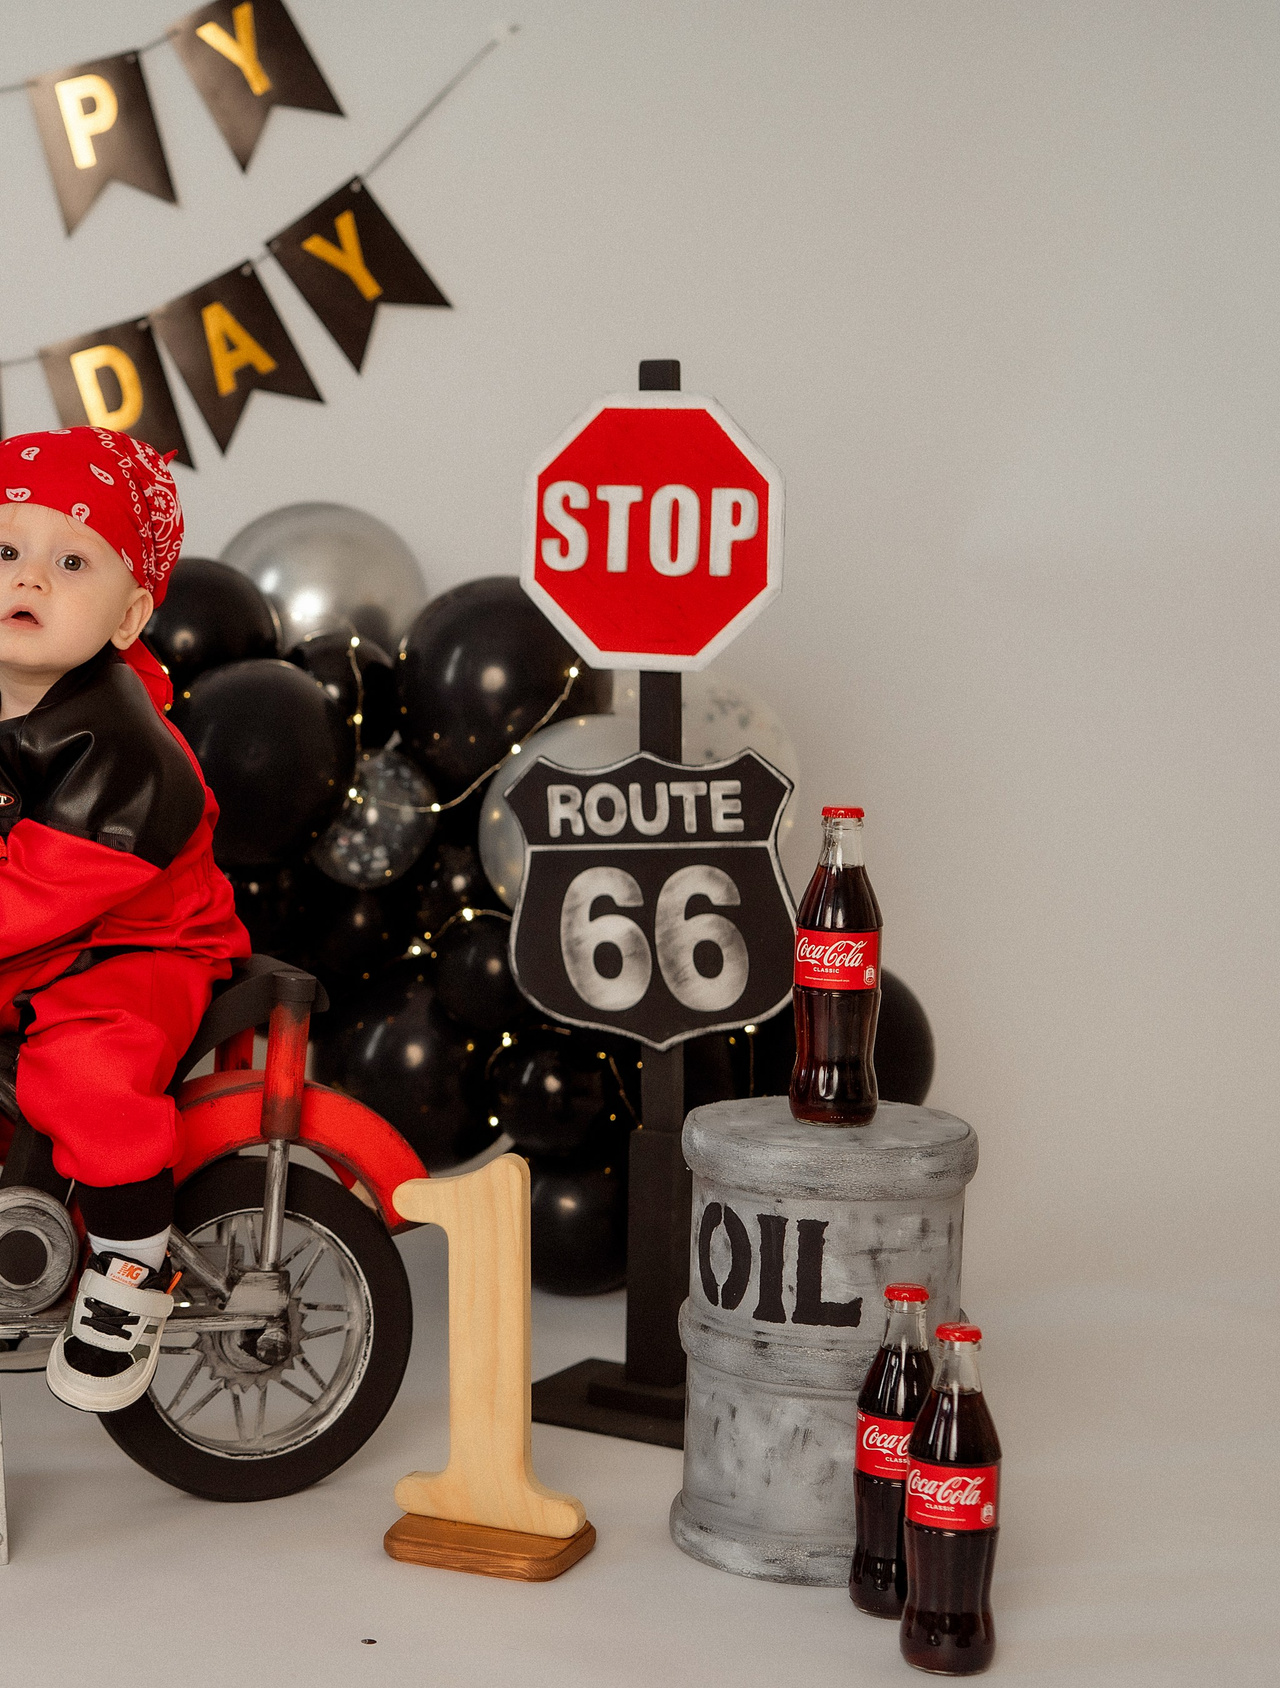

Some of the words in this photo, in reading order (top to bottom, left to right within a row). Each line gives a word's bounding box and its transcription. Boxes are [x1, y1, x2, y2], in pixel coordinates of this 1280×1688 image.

[540, 479, 759, 577] STOP
[546, 779, 745, 838] ROUTE
[560, 863, 750, 1013] 66
[796, 936, 868, 967] Coca-Cola
[813, 966, 840, 974] CLASSIC
[698, 1201, 863, 1328] OIL
[862, 1425, 911, 1456] Coca-C
[885, 1456, 907, 1464] CLASS
[907, 1469, 985, 1506] Coca-Cola
[924, 1502, 955, 1512] CLASSIC
